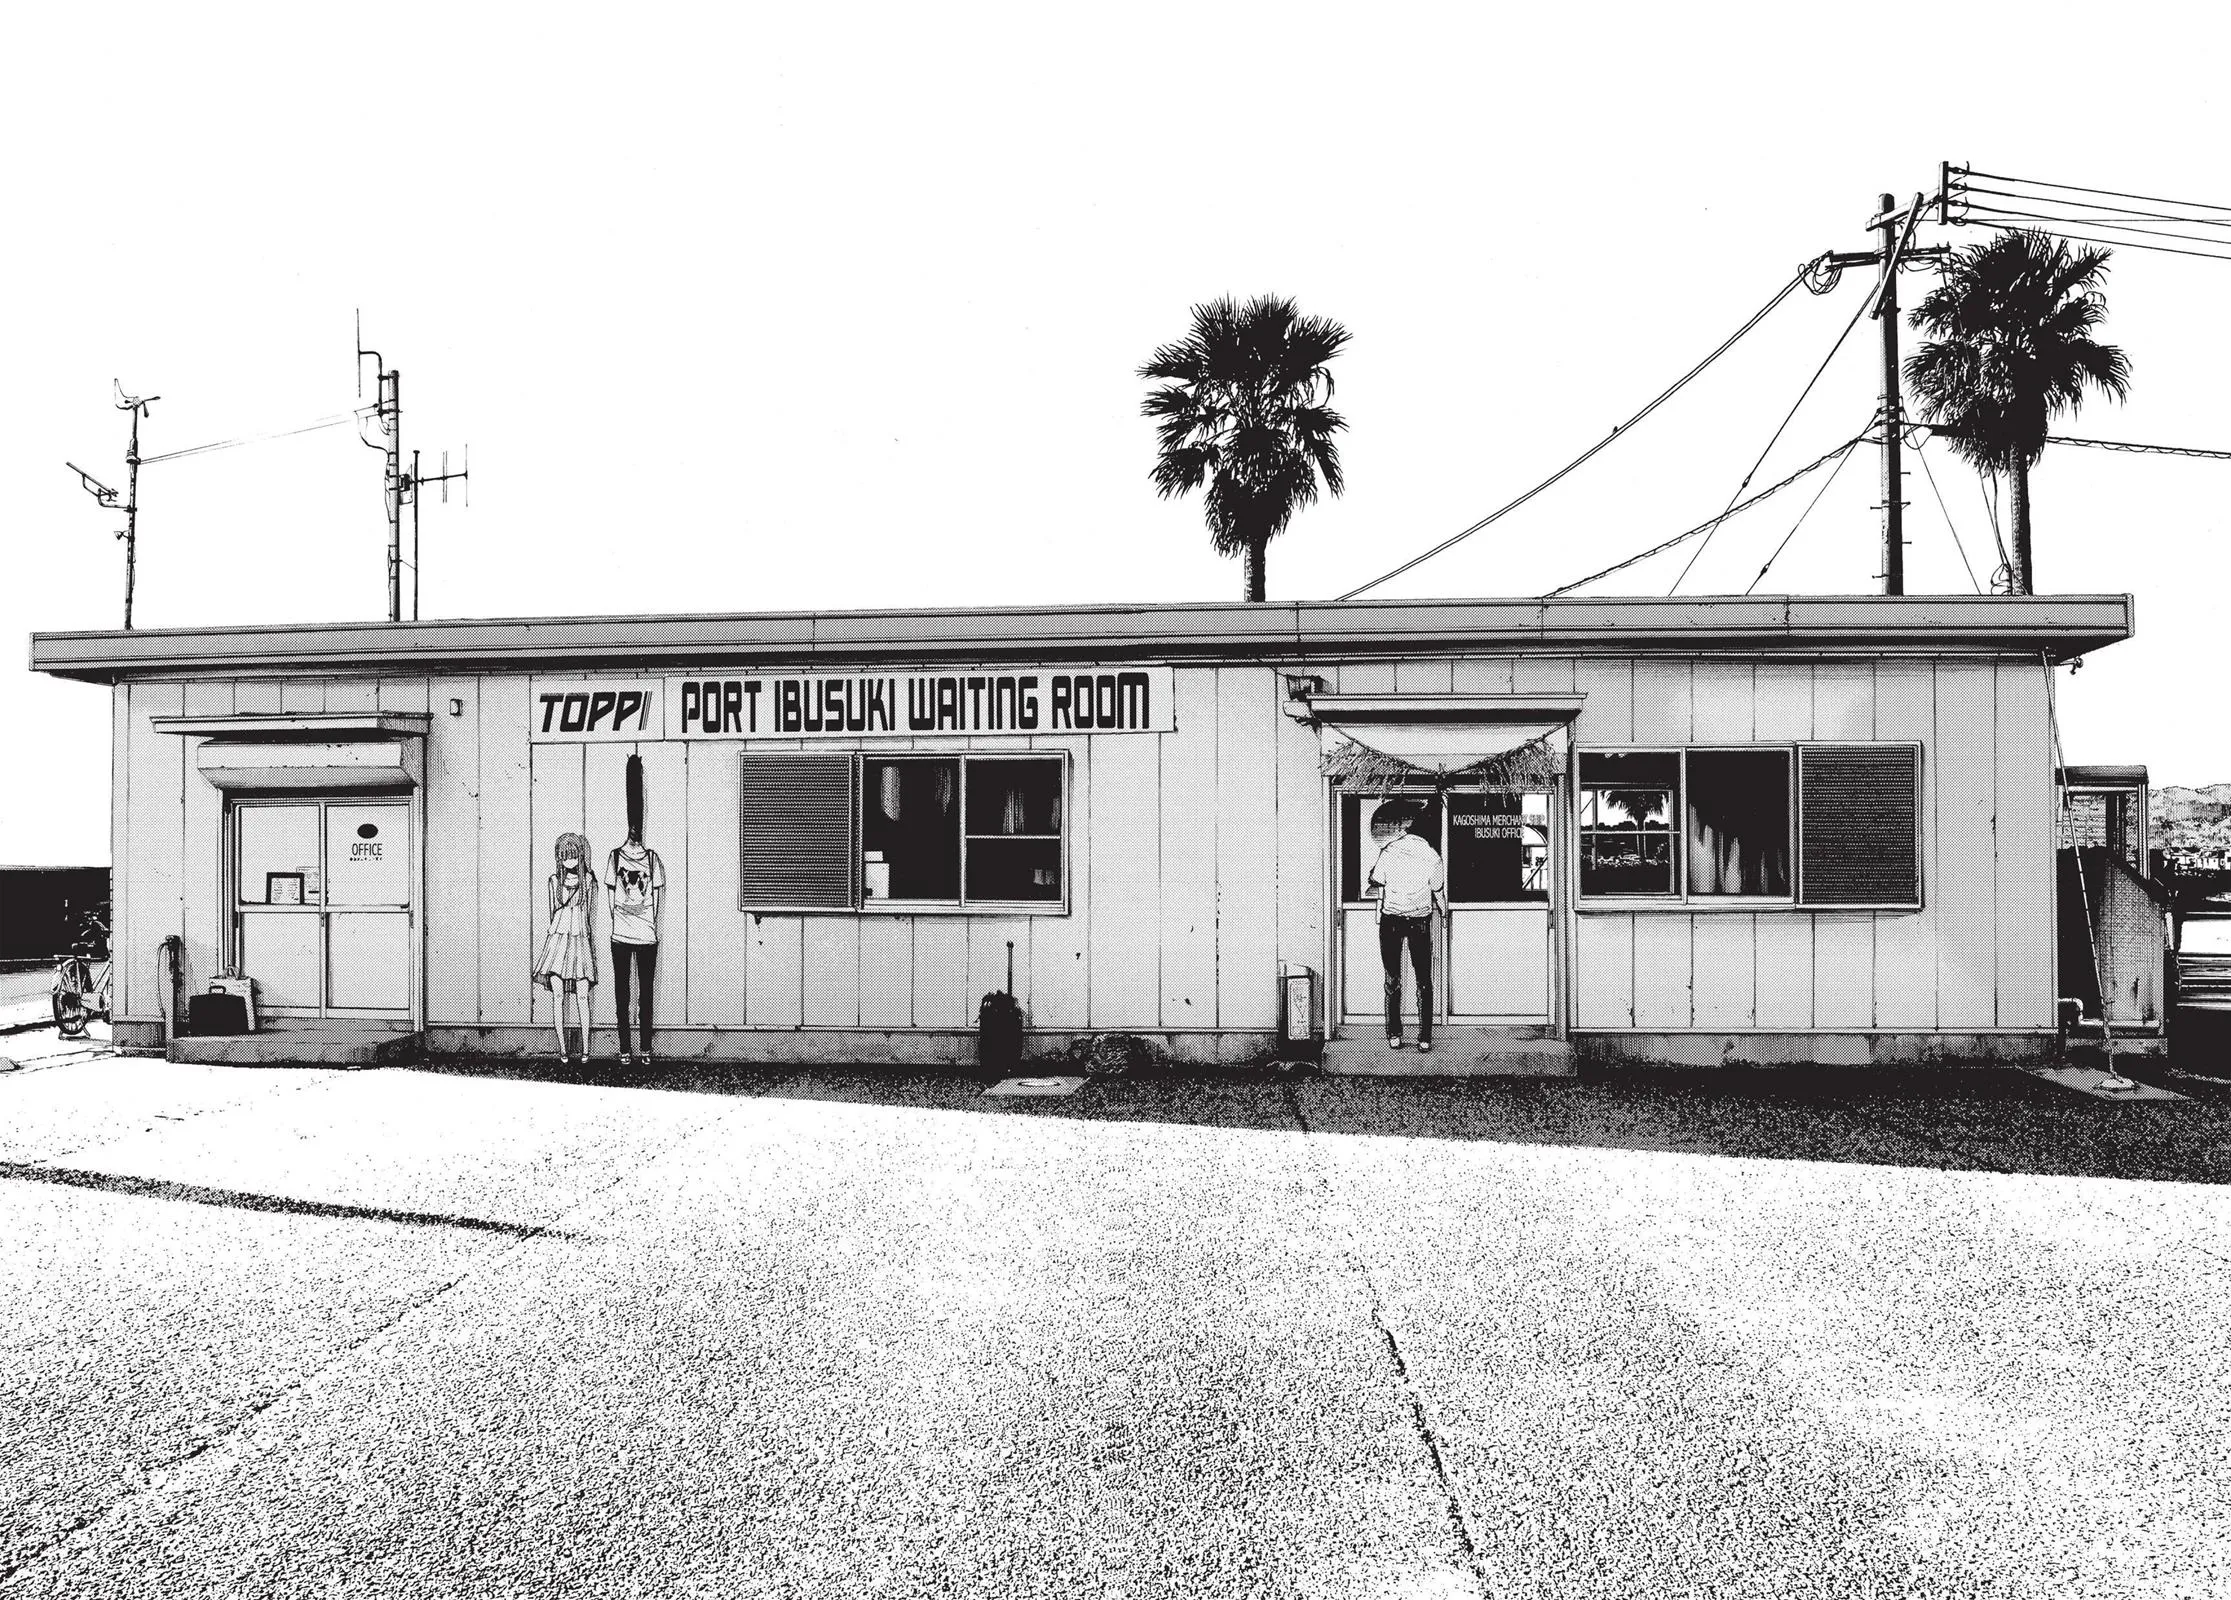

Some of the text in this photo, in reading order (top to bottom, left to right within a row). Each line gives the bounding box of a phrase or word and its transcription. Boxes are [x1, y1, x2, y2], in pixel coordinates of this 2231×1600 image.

[682, 672, 1150, 733] PORT IBUSUKI WAITING ROOM
[540, 691, 653, 732] TOPPI
[1453, 815, 1491, 826] KAGOSHIMA
[1492, 814, 1528, 826] MERCHANT
[1475, 827, 1525, 839] IBUSUKI OFFICE
[352, 843, 383, 856] OFFICE
